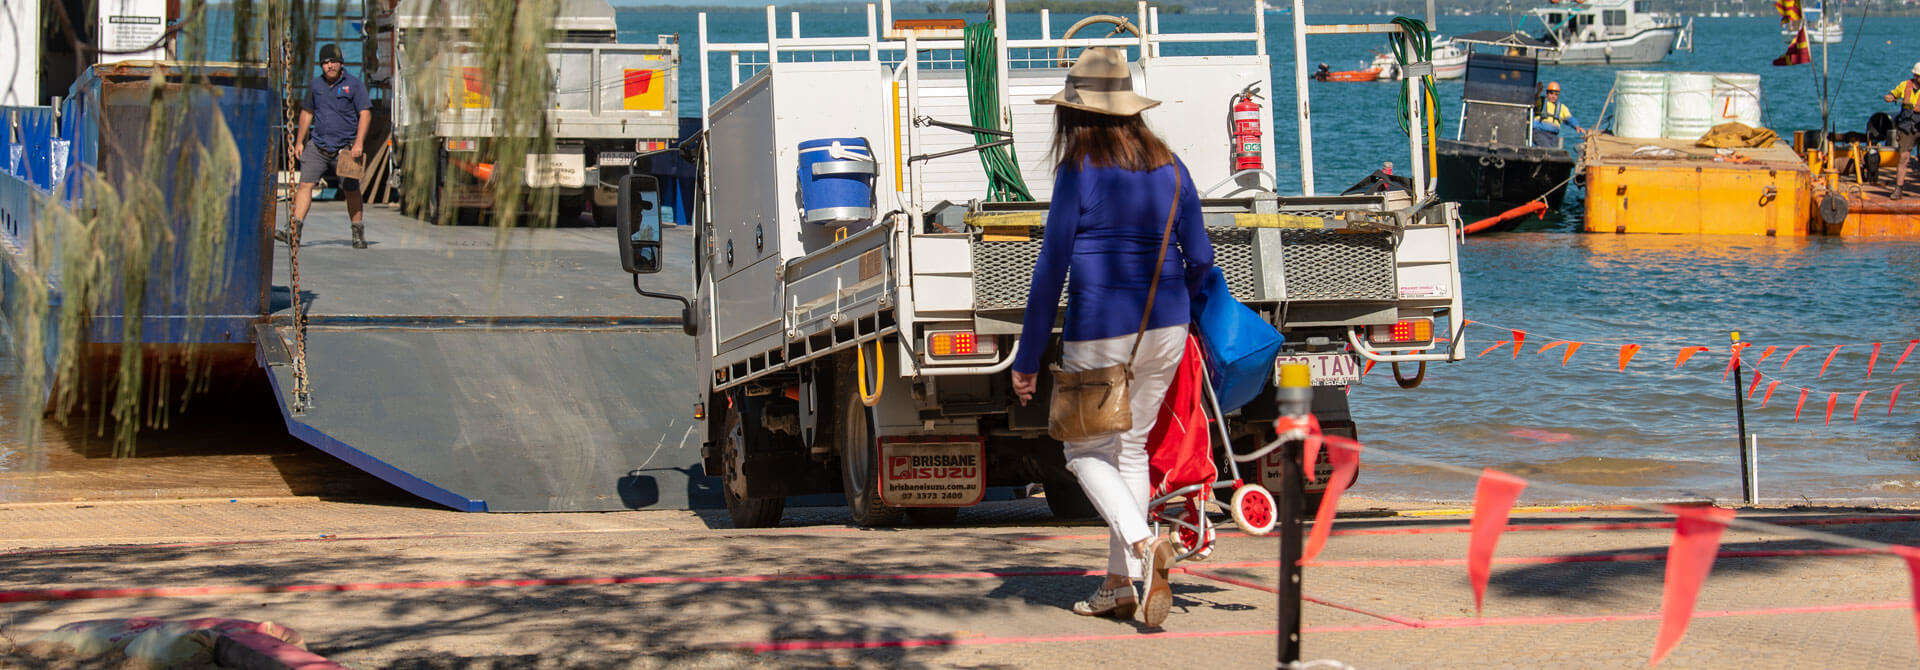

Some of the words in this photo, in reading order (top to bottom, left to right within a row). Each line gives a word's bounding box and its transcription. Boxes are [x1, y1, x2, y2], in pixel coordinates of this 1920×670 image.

[912, 455, 977, 467] BRISBANE
[912, 467, 977, 479] ISUZU
[889, 483, 977, 492] brisbaneisuzu.com.au
[902, 492, 913, 500] 07
